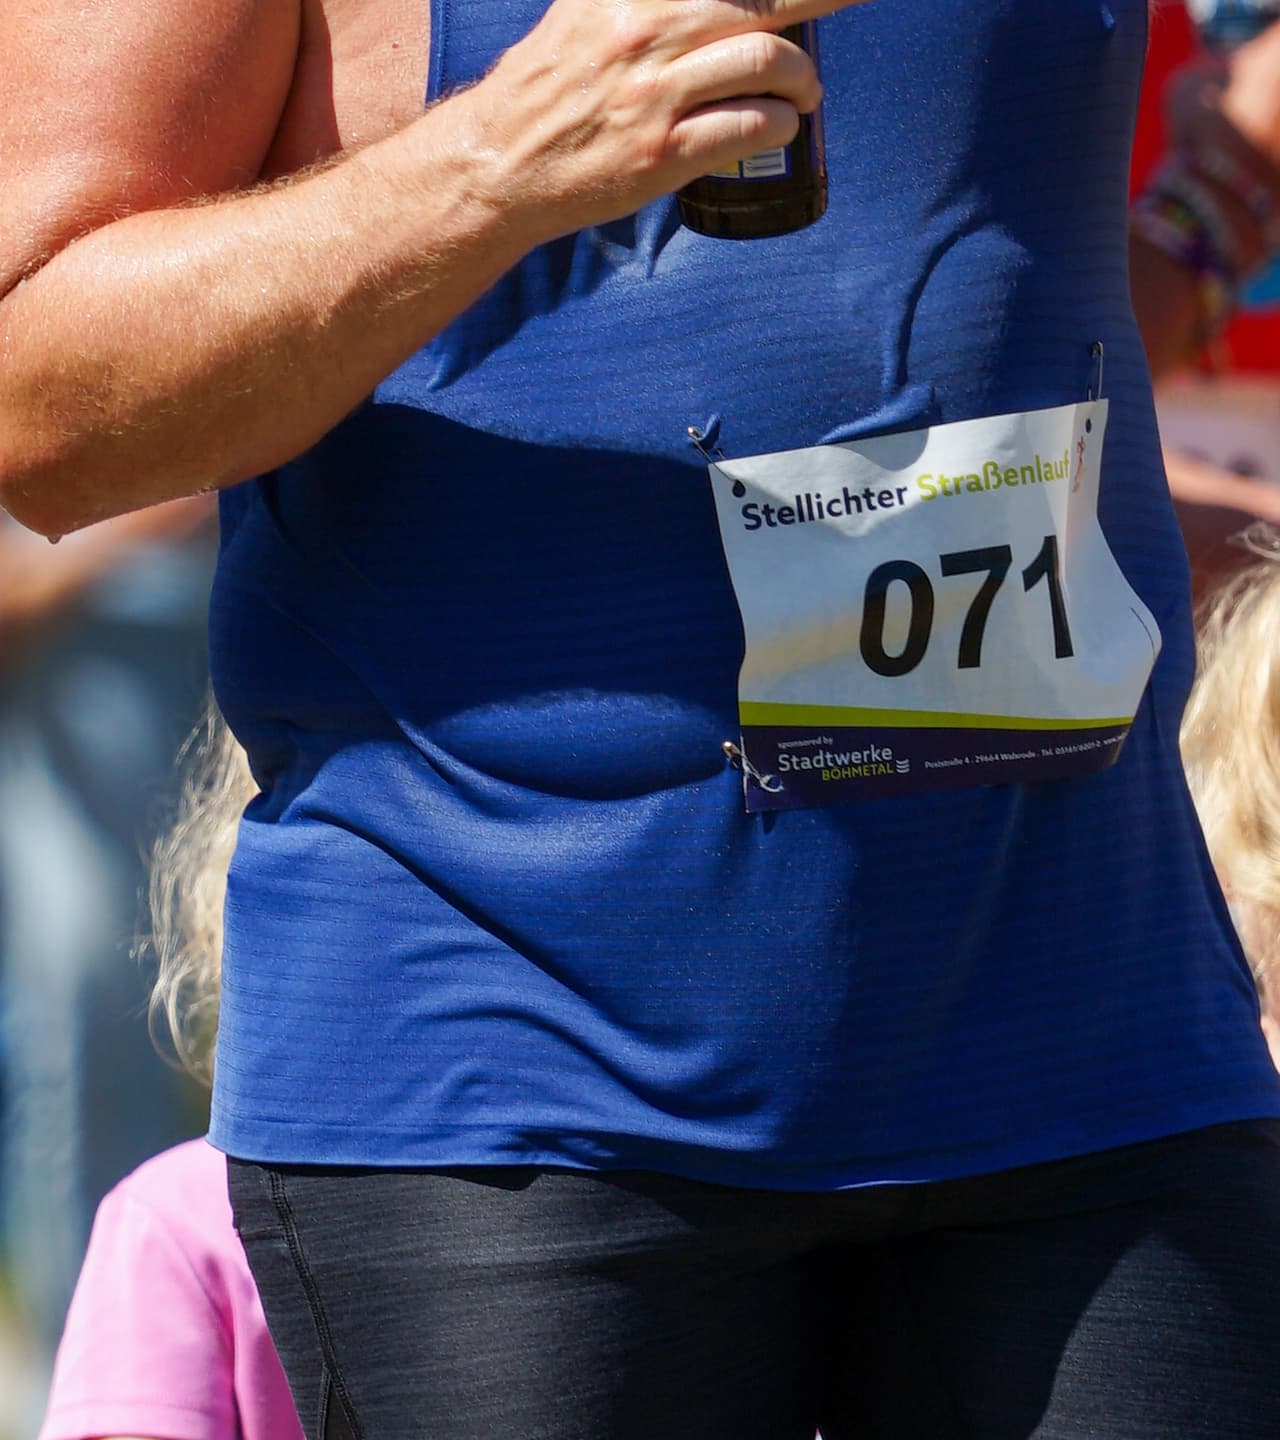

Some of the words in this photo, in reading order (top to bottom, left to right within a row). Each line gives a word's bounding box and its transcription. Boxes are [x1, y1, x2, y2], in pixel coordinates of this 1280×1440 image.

[741, 486, 907, 531] Stellichter
[916, 448, 1070, 502] Straßenlauf
[859, 535, 1074, 678] 071
[778, 737, 820, 750] sponsored
[823, 735, 833, 746] by
[778, 744, 892, 771] Stadtwerke
[822, 763, 894, 781] BÖHMETAL
